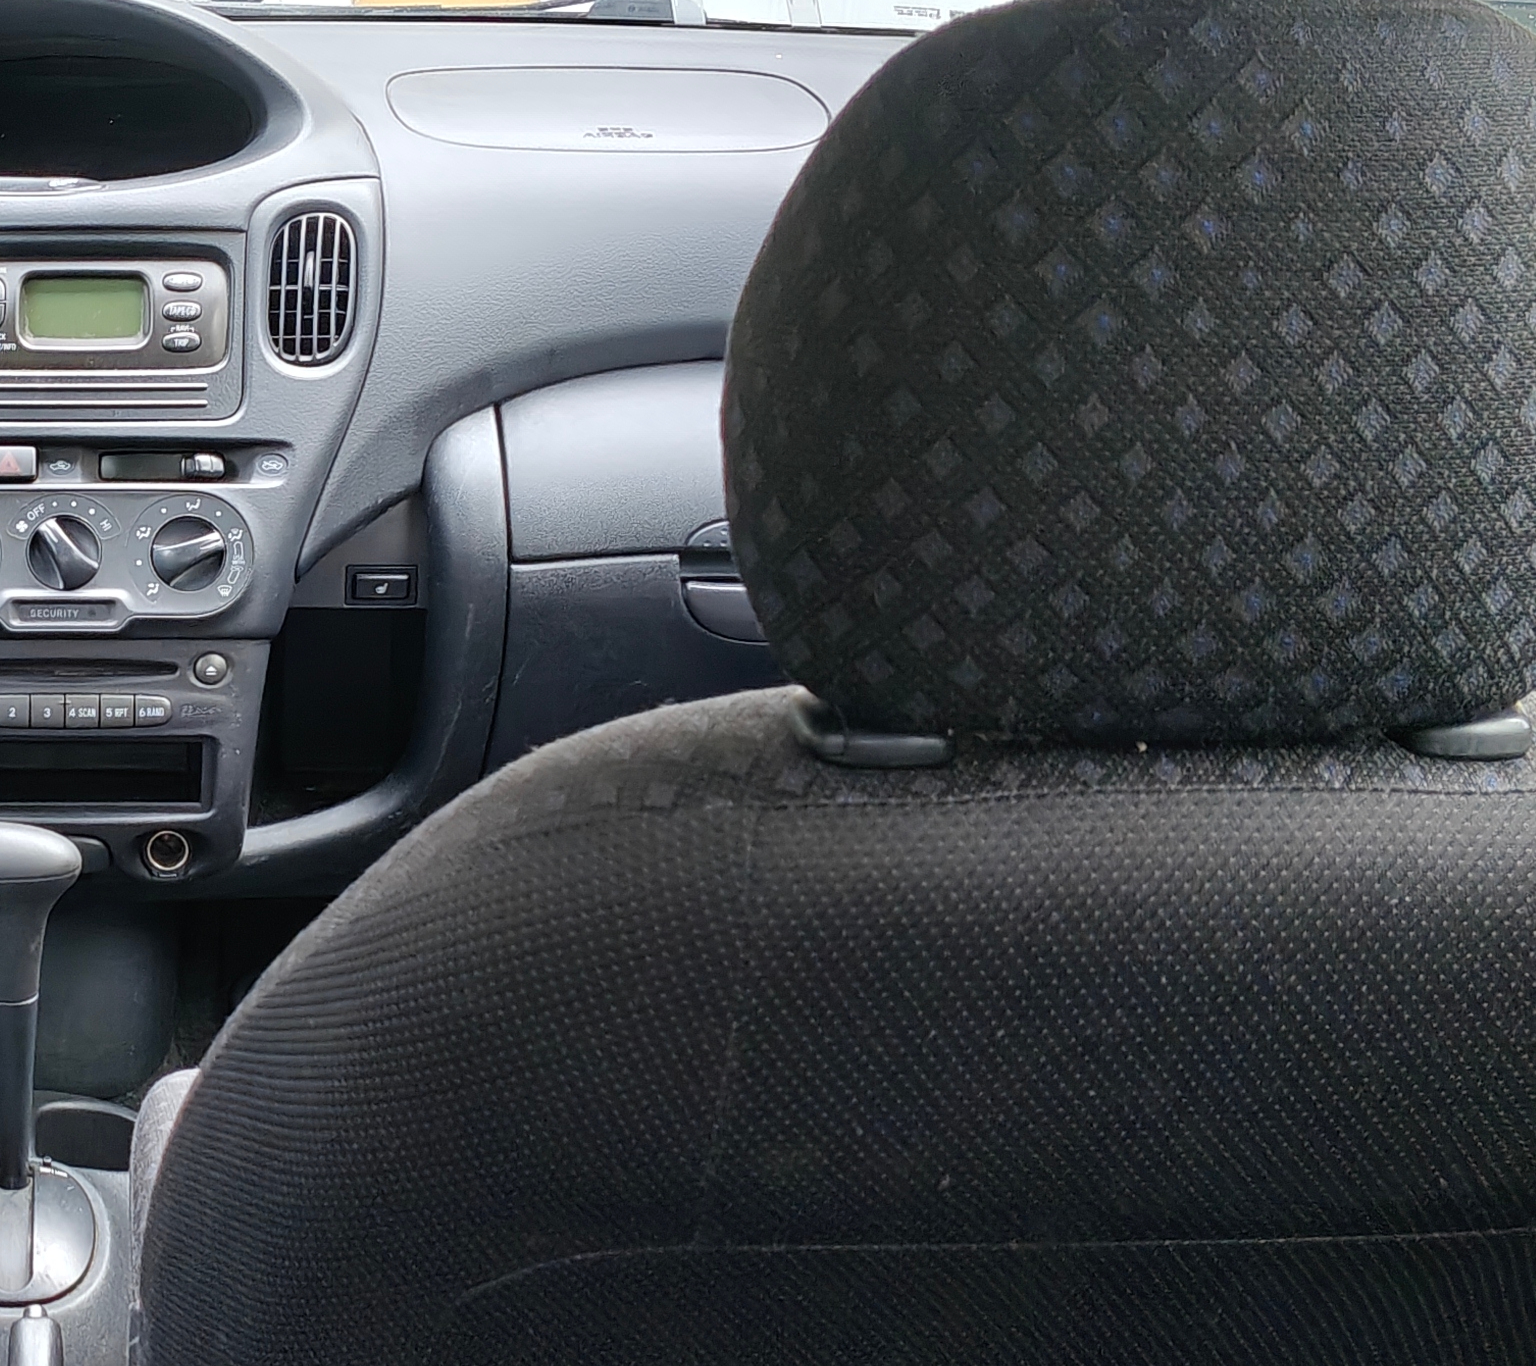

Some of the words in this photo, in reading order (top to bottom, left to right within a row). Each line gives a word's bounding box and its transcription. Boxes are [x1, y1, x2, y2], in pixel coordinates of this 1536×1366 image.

[26, 503, 45, 521] OFF
[99, 519, 112, 531] HI
[29, 608, 80, 618] SECURITY
[8, 707, 17, 718] 2
[43, 708, 52, 718] 3
[68, 707, 77, 717] 4
[78, 707, 97, 717] SCAN
[105, 707, 114, 717] 5
[138, 707, 146, 717] 6
